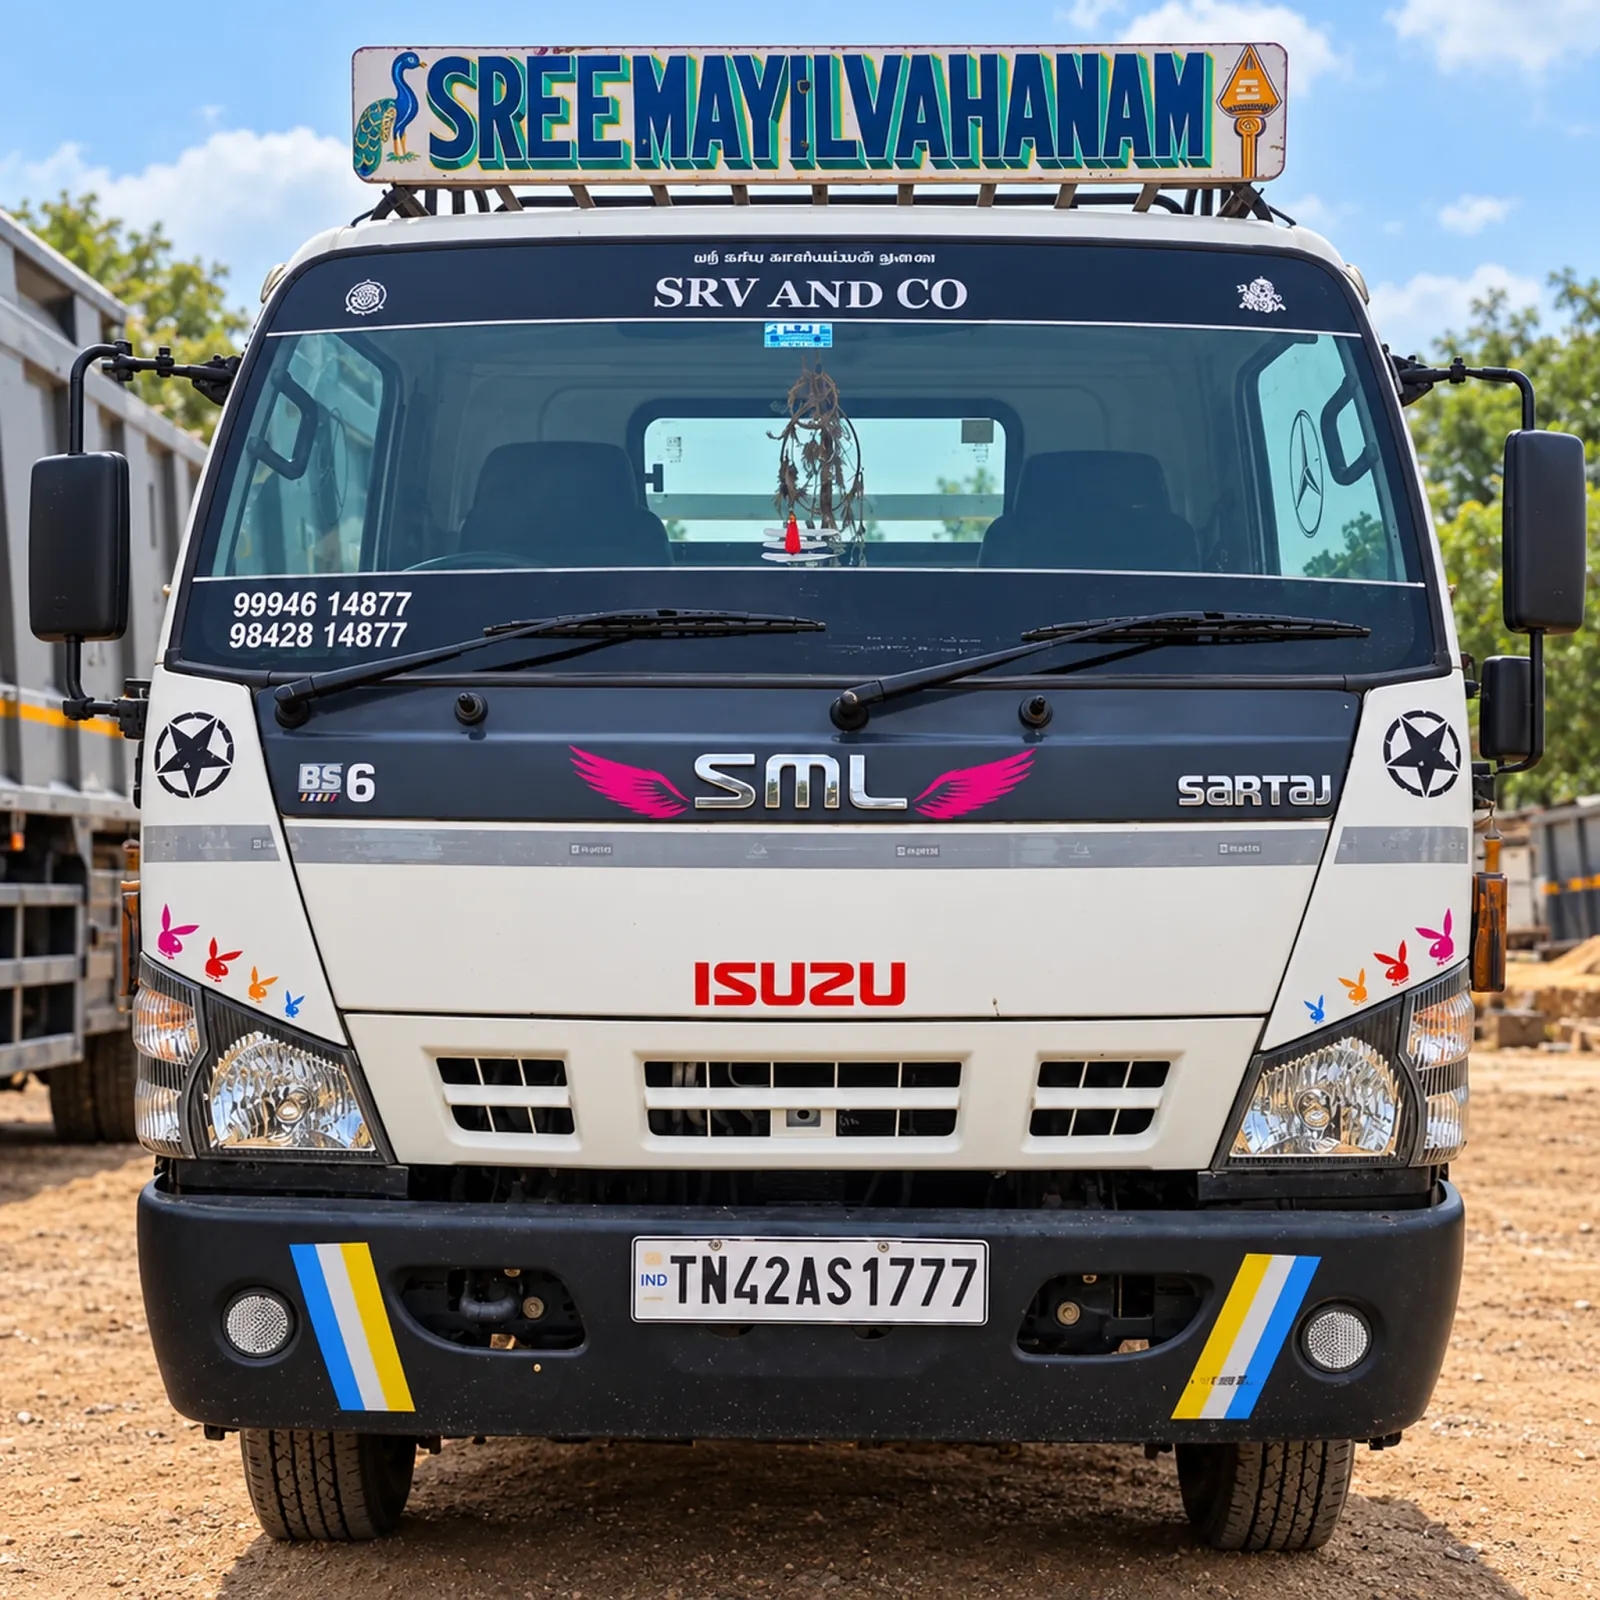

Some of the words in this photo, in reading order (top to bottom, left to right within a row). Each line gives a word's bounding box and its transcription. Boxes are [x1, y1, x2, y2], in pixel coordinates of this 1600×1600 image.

[654, 277, 759, 308] SRV
[767, 280, 883, 308] AND
[897, 278, 967, 309] CO
[233, 592, 317, 617] 99946
[327, 591, 412, 616] 14877
[229, 622, 313, 648] 98428
[323, 622, 408, 647] 14877
[694, 753, 907, 809] SML
[694, 962, 906, 1006] ISUZU
[640, 1273, 668, 1287] IND
